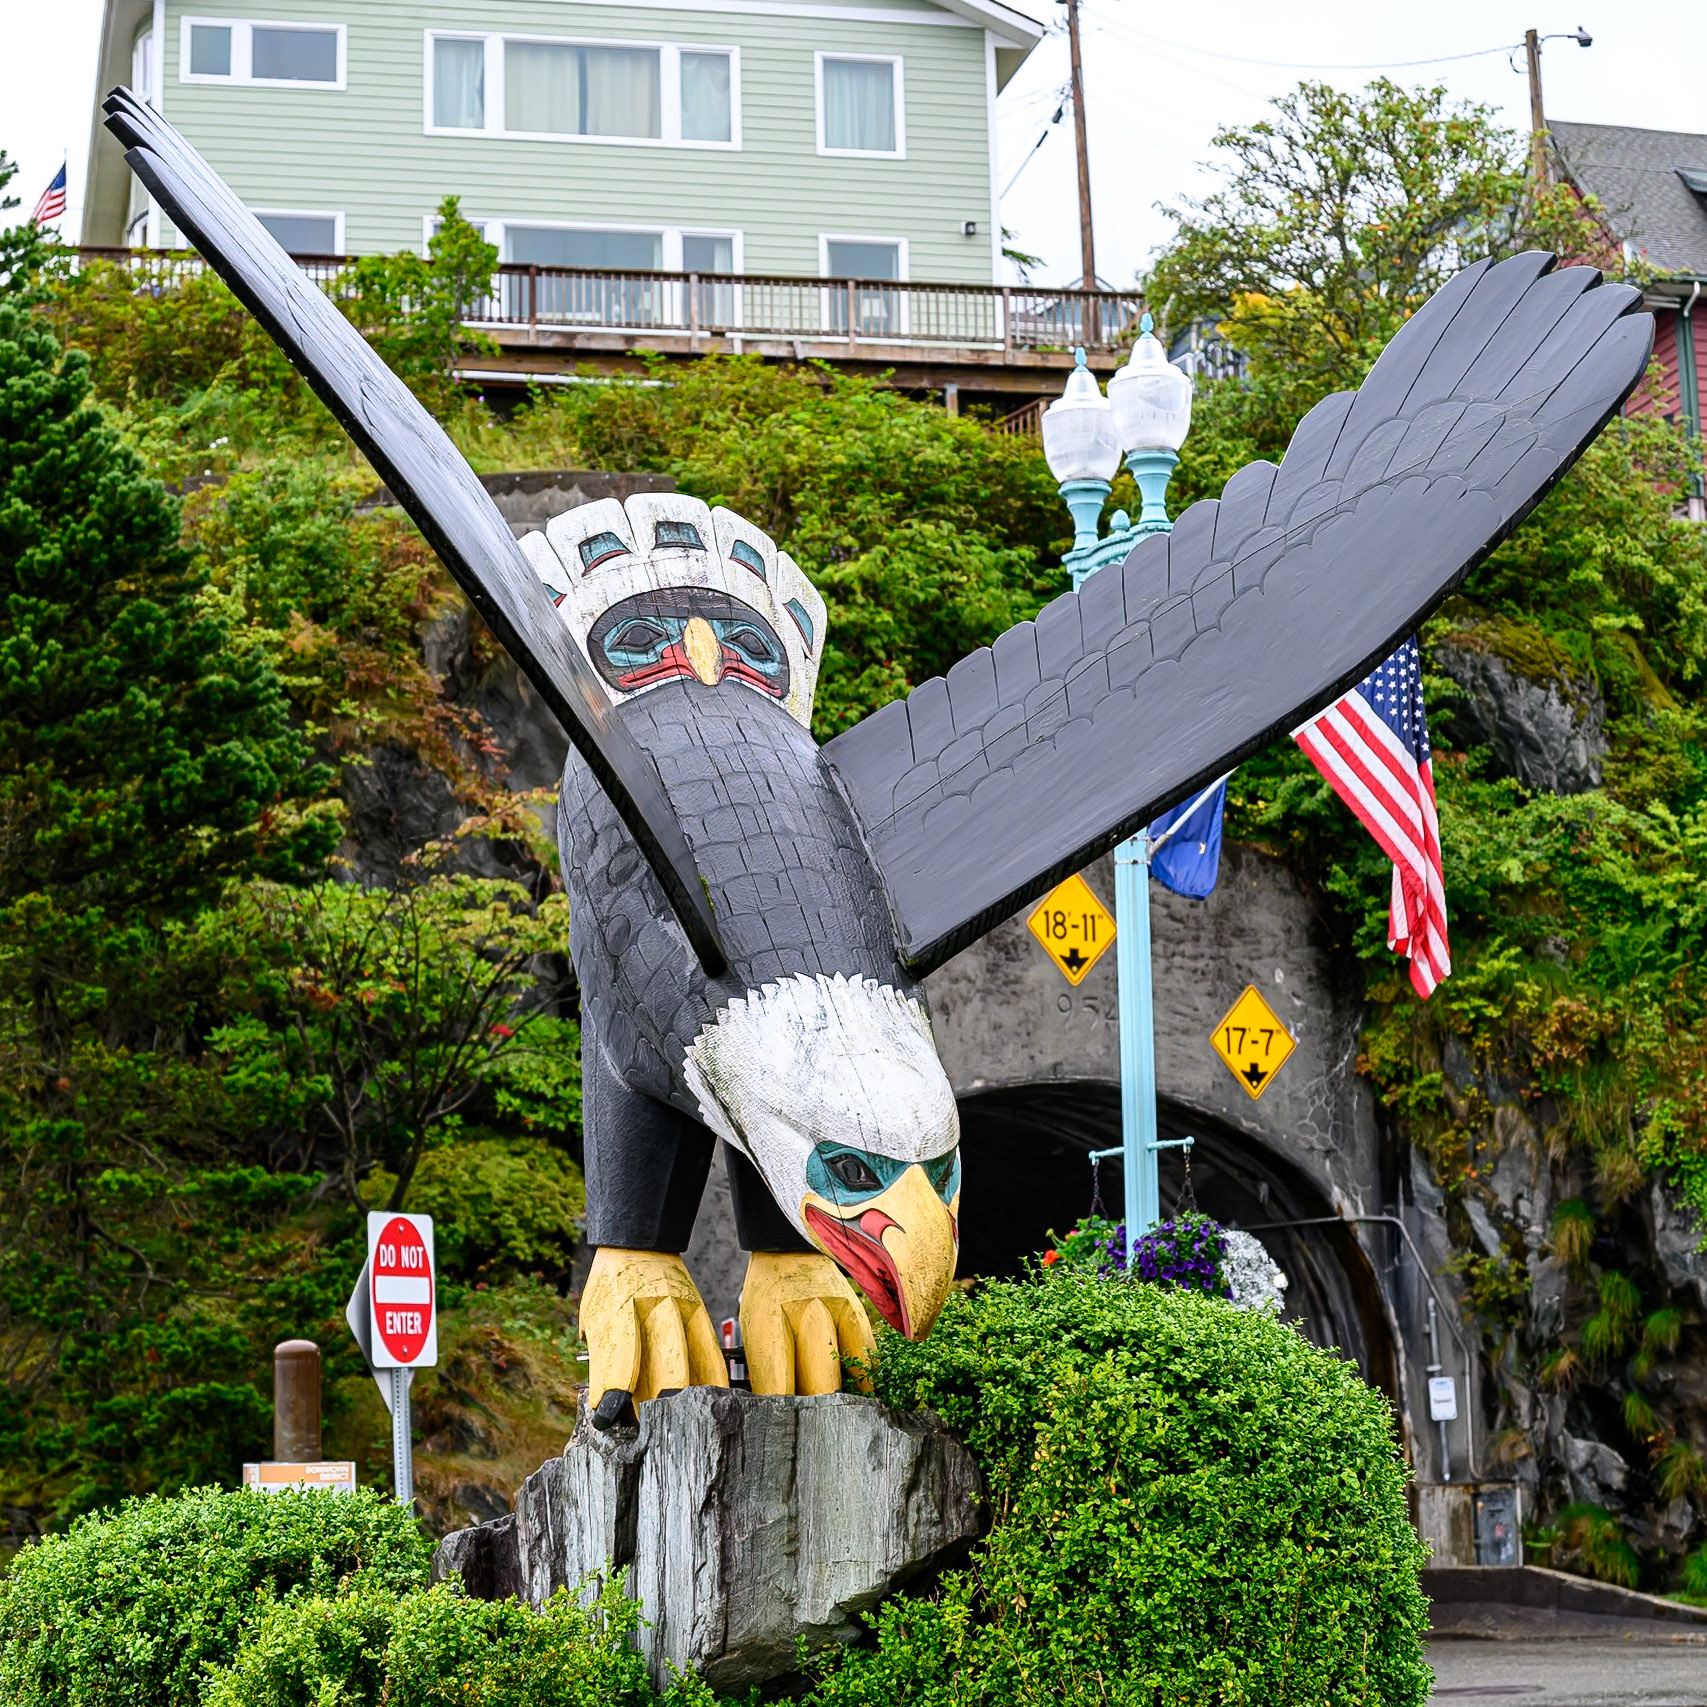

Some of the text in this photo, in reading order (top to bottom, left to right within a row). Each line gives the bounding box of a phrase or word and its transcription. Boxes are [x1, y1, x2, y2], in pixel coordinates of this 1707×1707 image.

[379, 1244, 424, 1269] DO NOT
[385, 1311, 422, 1335] ENTER
